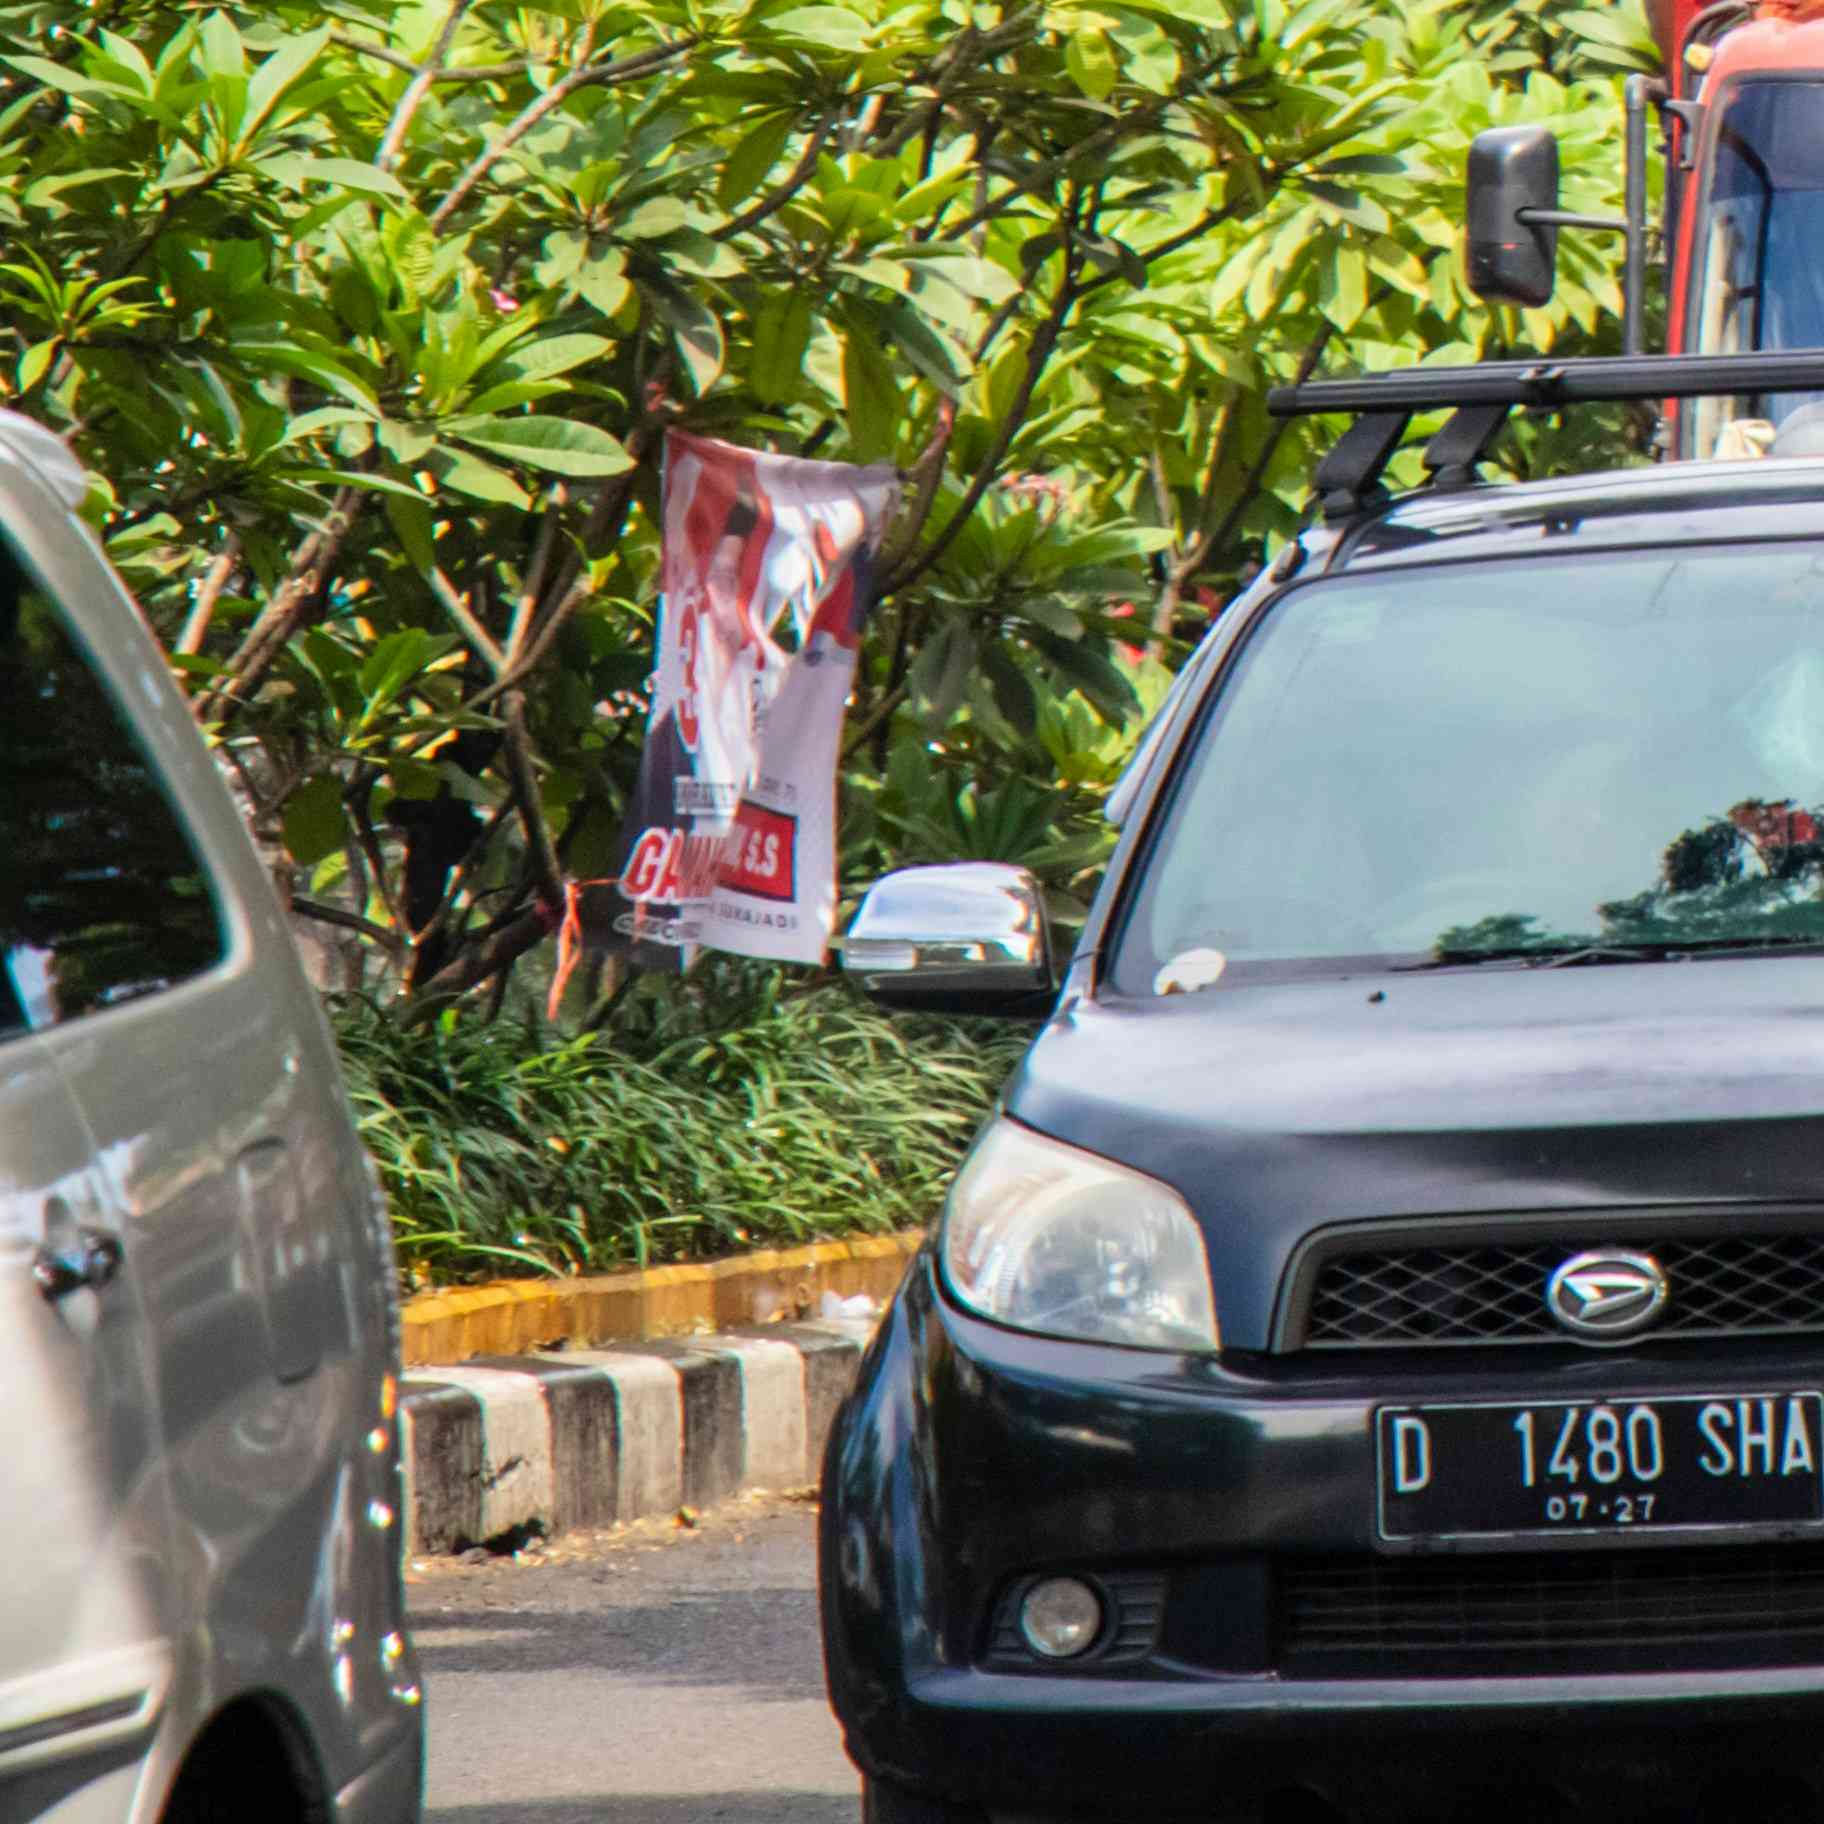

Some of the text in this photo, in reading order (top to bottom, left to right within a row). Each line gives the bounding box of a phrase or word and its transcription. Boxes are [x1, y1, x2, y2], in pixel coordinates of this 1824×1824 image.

[1394, 1396, 1814, 1493] D 1480 SHA
